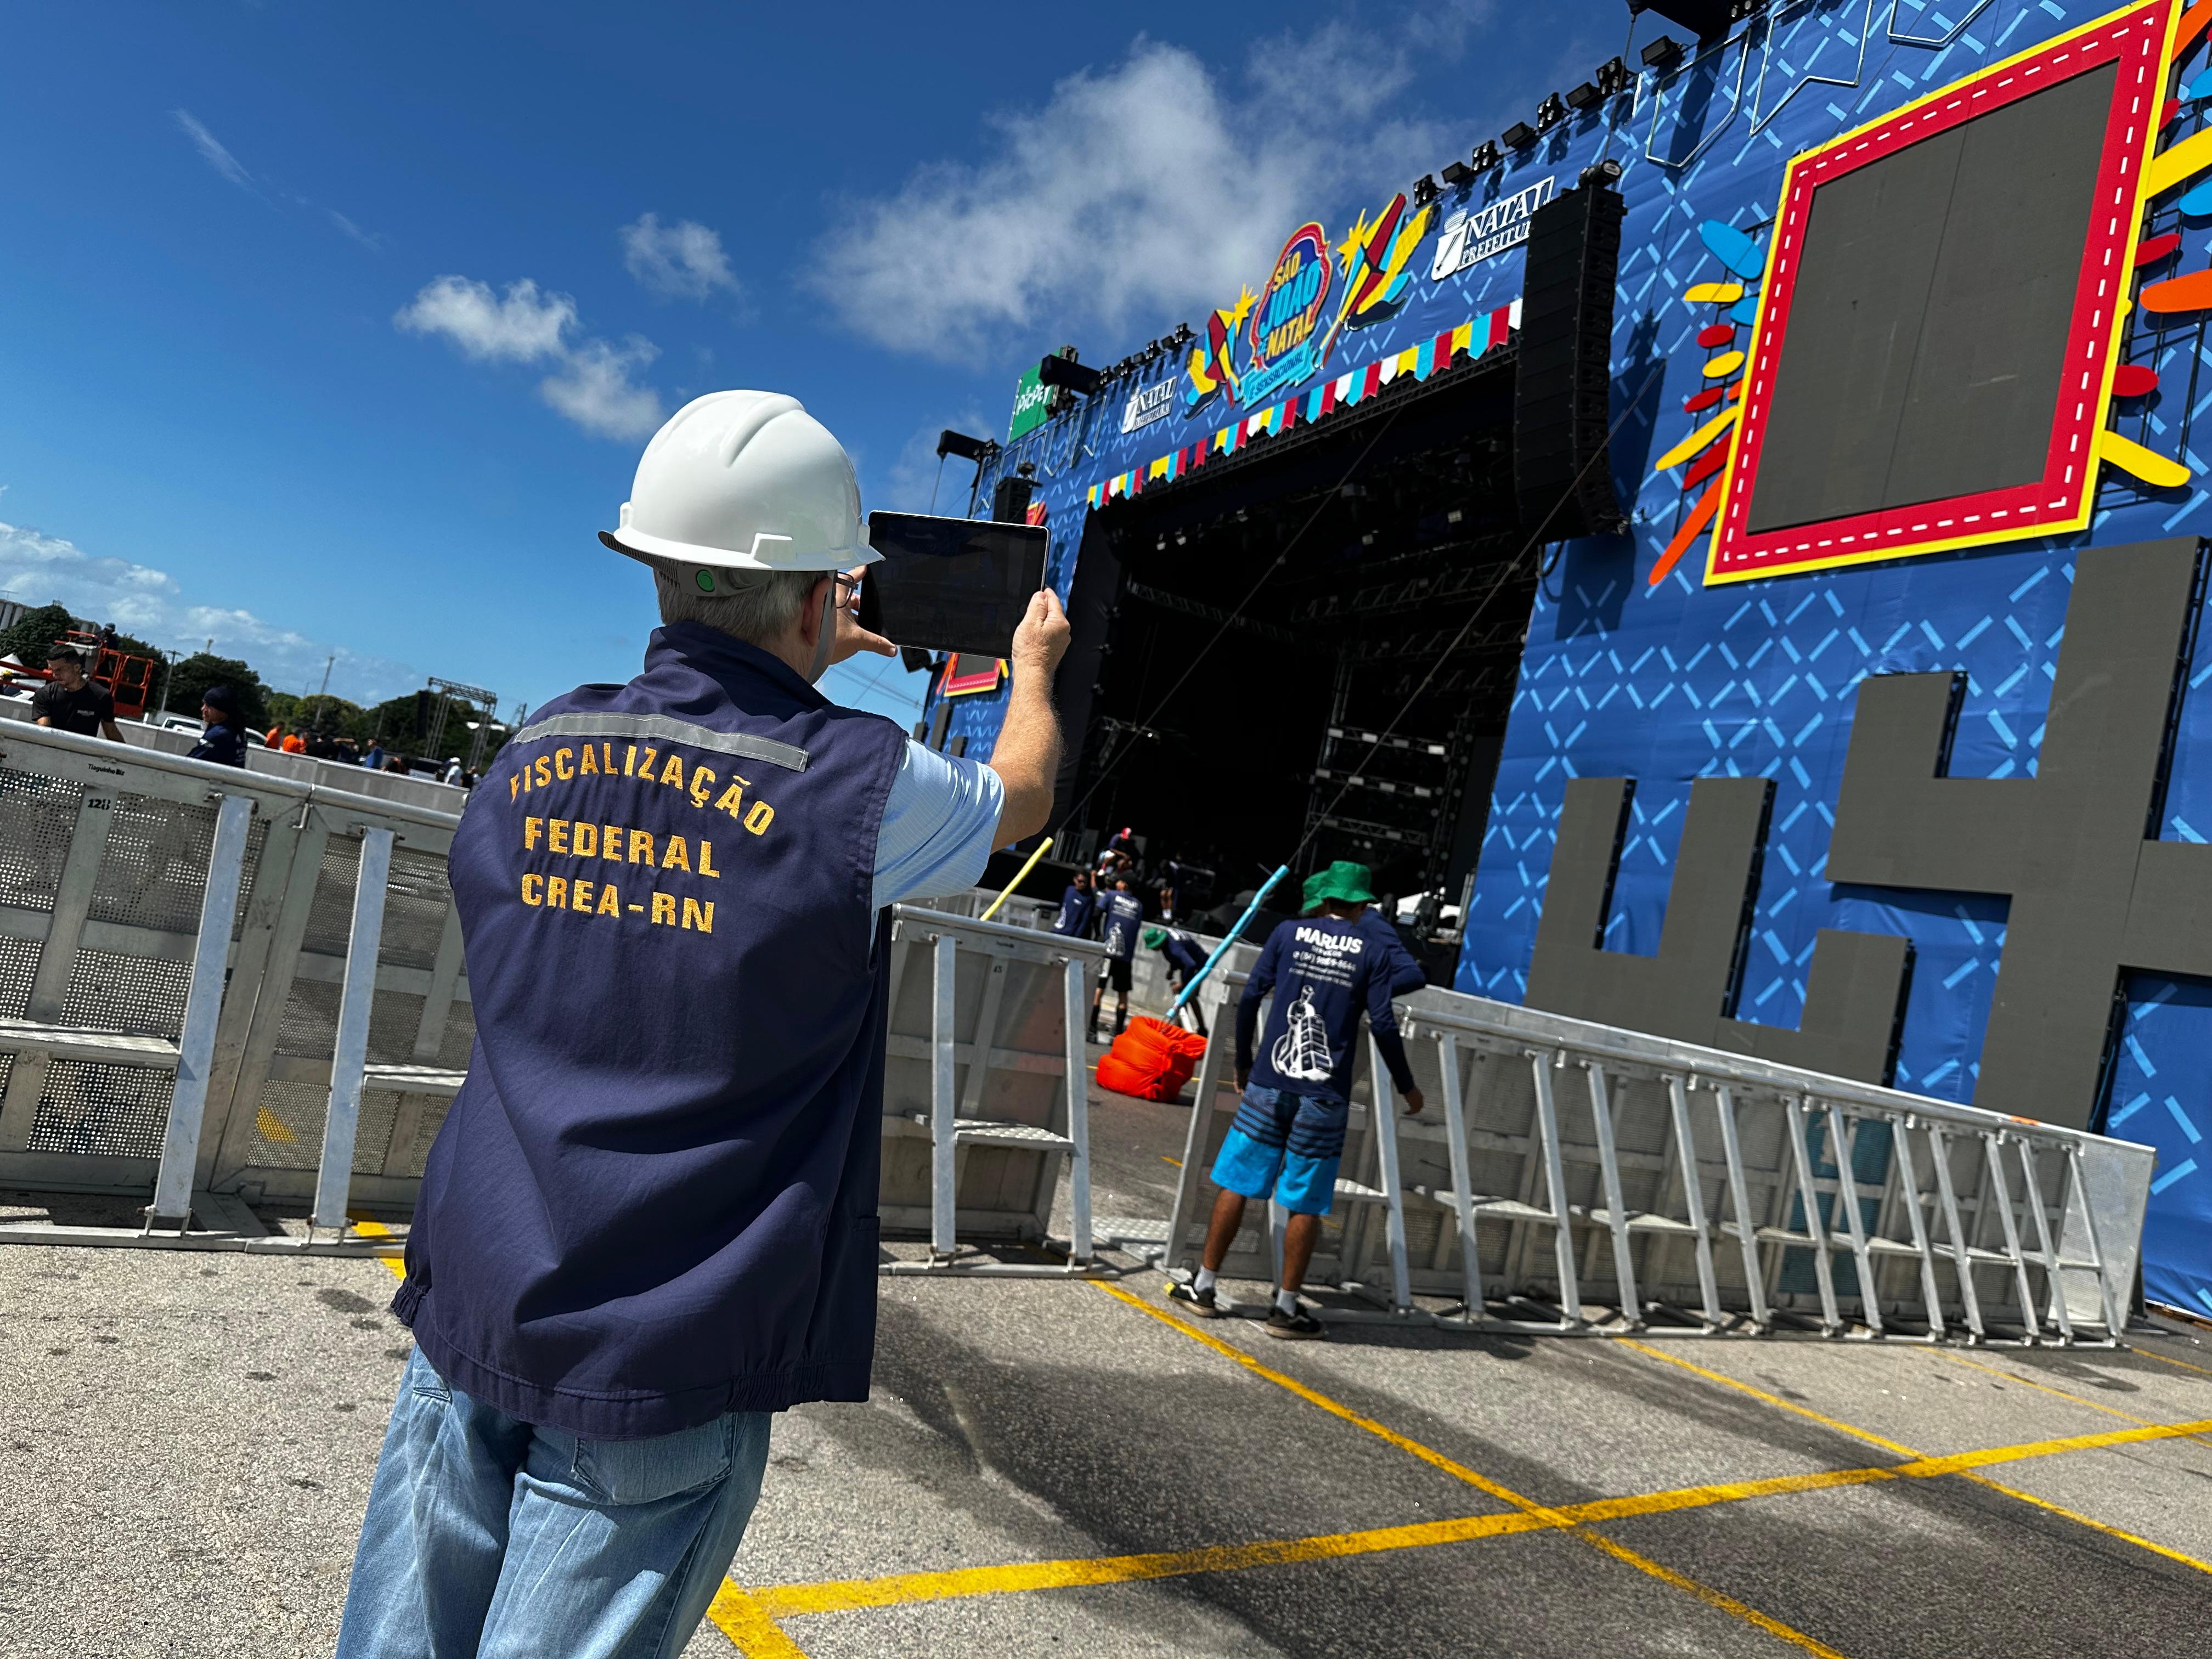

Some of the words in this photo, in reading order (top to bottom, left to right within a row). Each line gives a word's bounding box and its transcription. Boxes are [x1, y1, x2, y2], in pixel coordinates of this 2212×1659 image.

[1465, 183, 1550, 246] NATAL
[1259, 259, 1321, 338] JOÃO
[1272, 250, 1301, 292] SÃO
[1265, 304, 1315, 361] NATAL
[1137, 381, 1173, 414] NATAL
[88, 764, 115, 774] Tiaguinho
[510, 742, 775, 836] FISCALIZAÇÃO
[88, 799, 111, 810] 128
[525, 816, 720, 878] FEDERAL
[522, 873, 714, 934] CREA-RN
[1295, 927, 1363, 953] MARLUS
